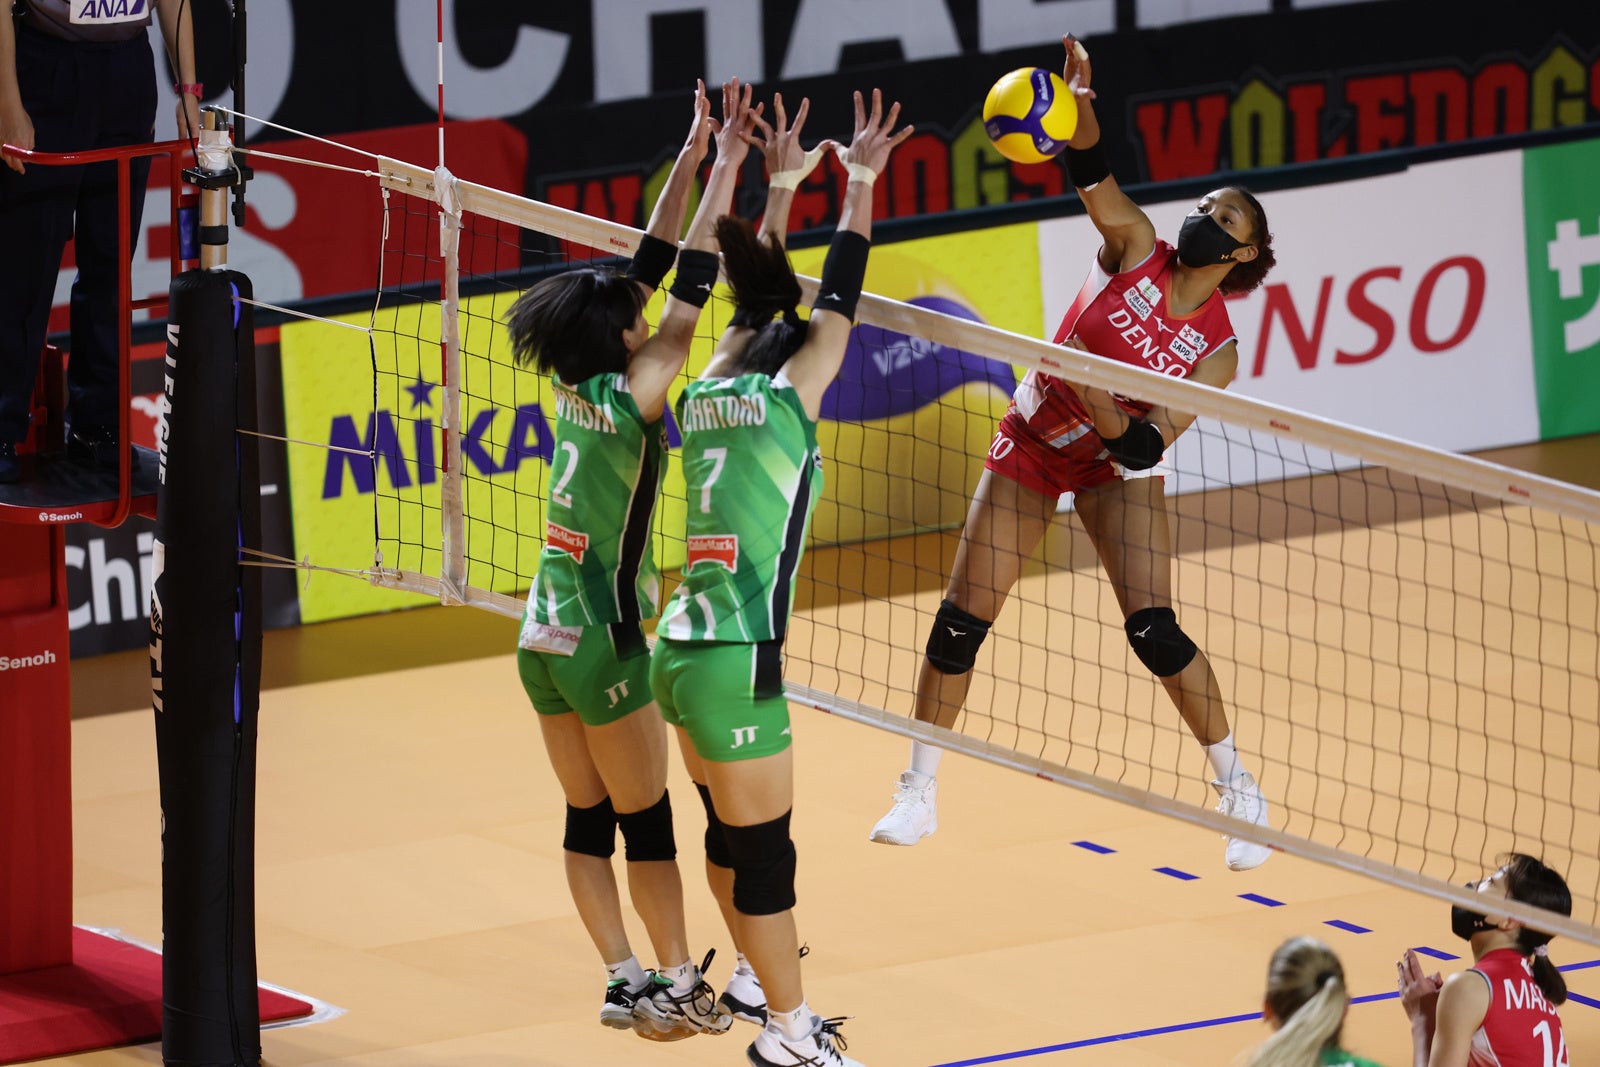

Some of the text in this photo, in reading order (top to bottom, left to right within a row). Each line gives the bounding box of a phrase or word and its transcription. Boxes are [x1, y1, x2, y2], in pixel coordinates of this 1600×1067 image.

[79, 0, 128, 19] ANA
[988, 432, 1014, 460] 20
[553, 441, 579, 508] 2
[701, 448, 727, 513] 7
[49, 511, 83, 522] Senoh
[0, 650, 56, 671] Senoh
[604, 679, 629, 709] JT
[730, 725, 759, 749] JT
